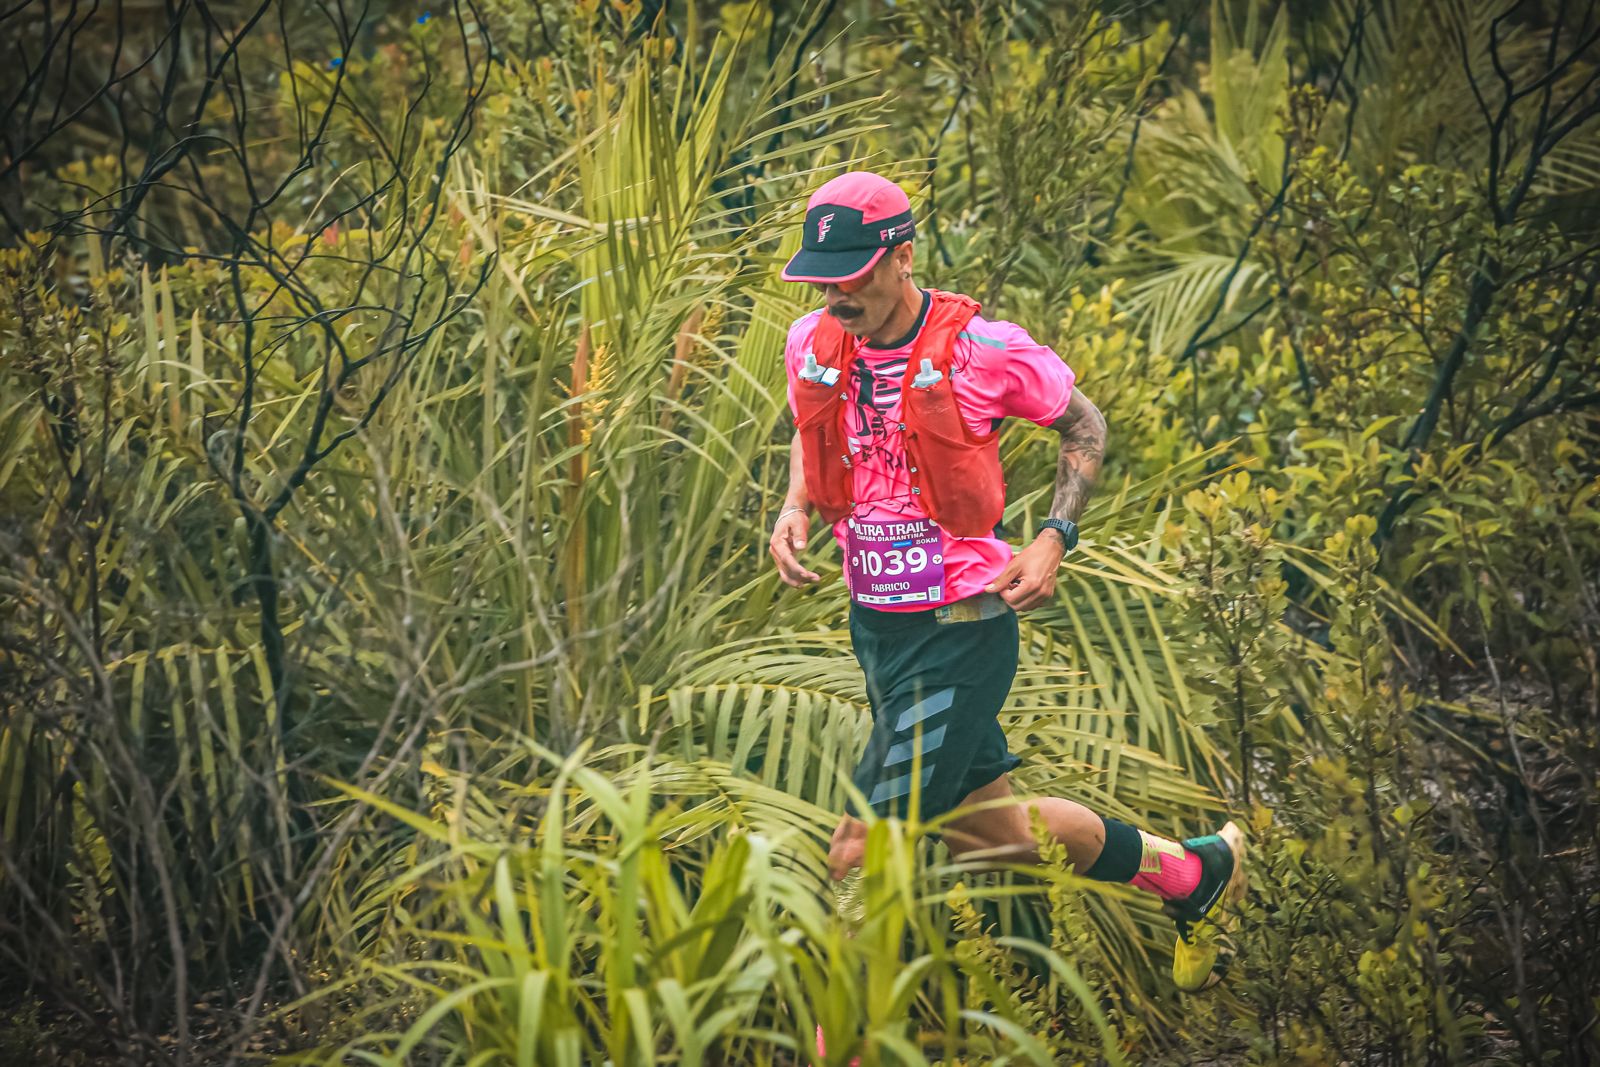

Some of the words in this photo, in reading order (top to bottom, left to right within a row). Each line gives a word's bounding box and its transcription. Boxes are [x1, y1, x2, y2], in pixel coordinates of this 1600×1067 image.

[855, 523, 885, 537] ULTRA
[886, 521, 929, 536] TRAIL
[877, 532, 925, 542] DIAMANTINA
[859, 547, 928, 577] 1039
[871, 581, 910, 593] FABRICIO
